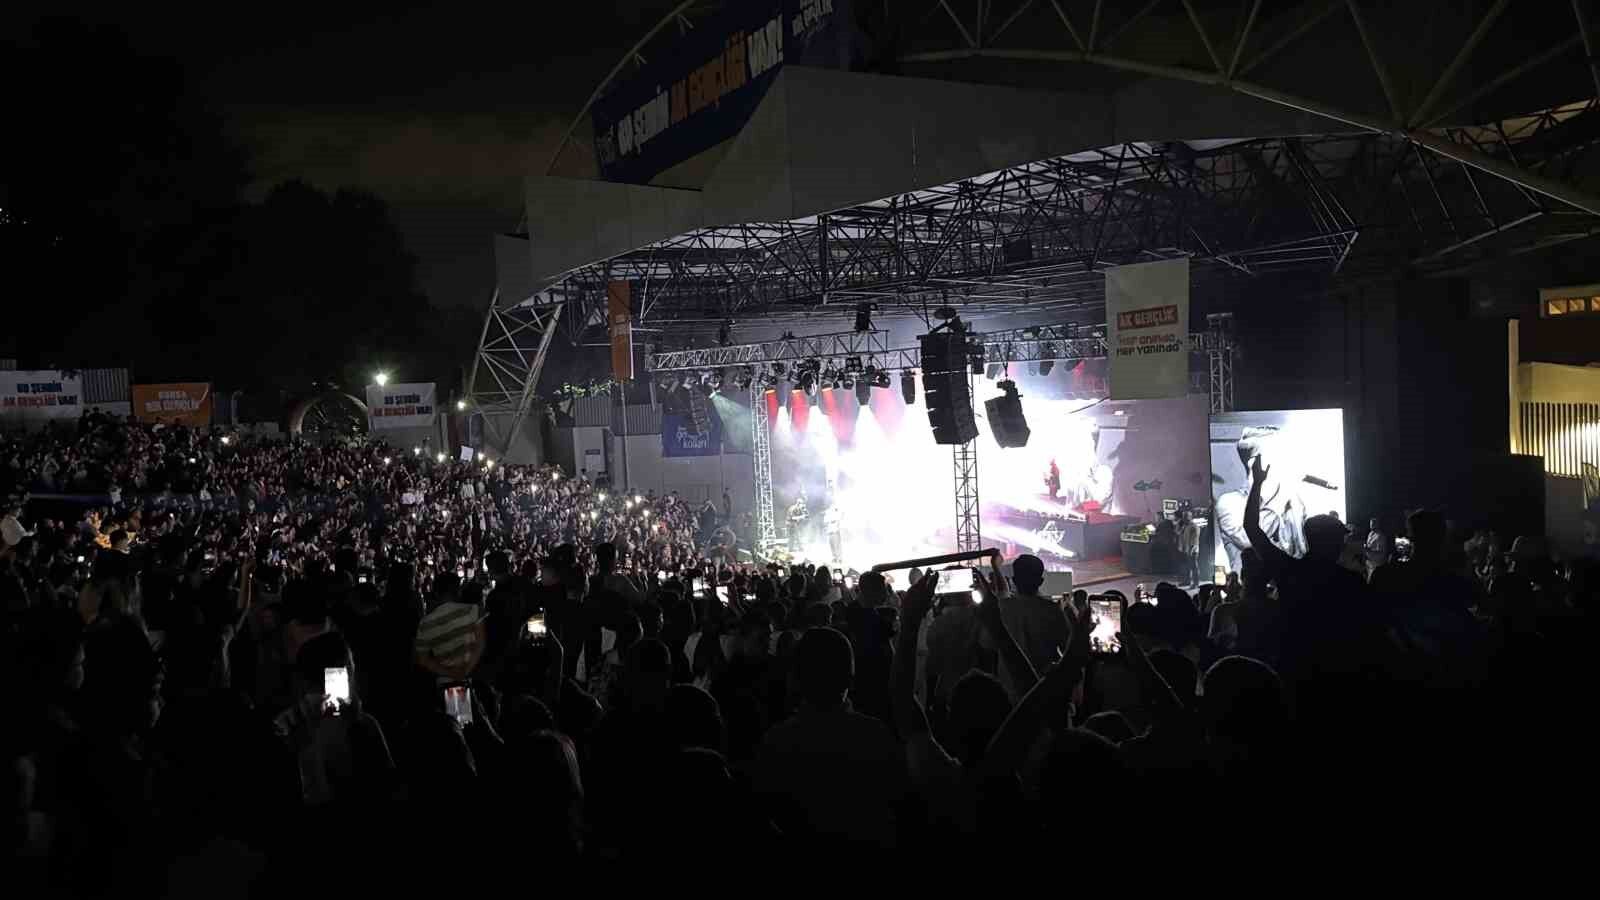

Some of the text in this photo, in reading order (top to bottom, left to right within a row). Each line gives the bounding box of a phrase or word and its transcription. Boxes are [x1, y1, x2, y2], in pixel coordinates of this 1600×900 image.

[633, 84, 670, 155] ŞEHRİN
[671, 79, 689, 124] AK
[747, 14, 785, 79] VAR!
